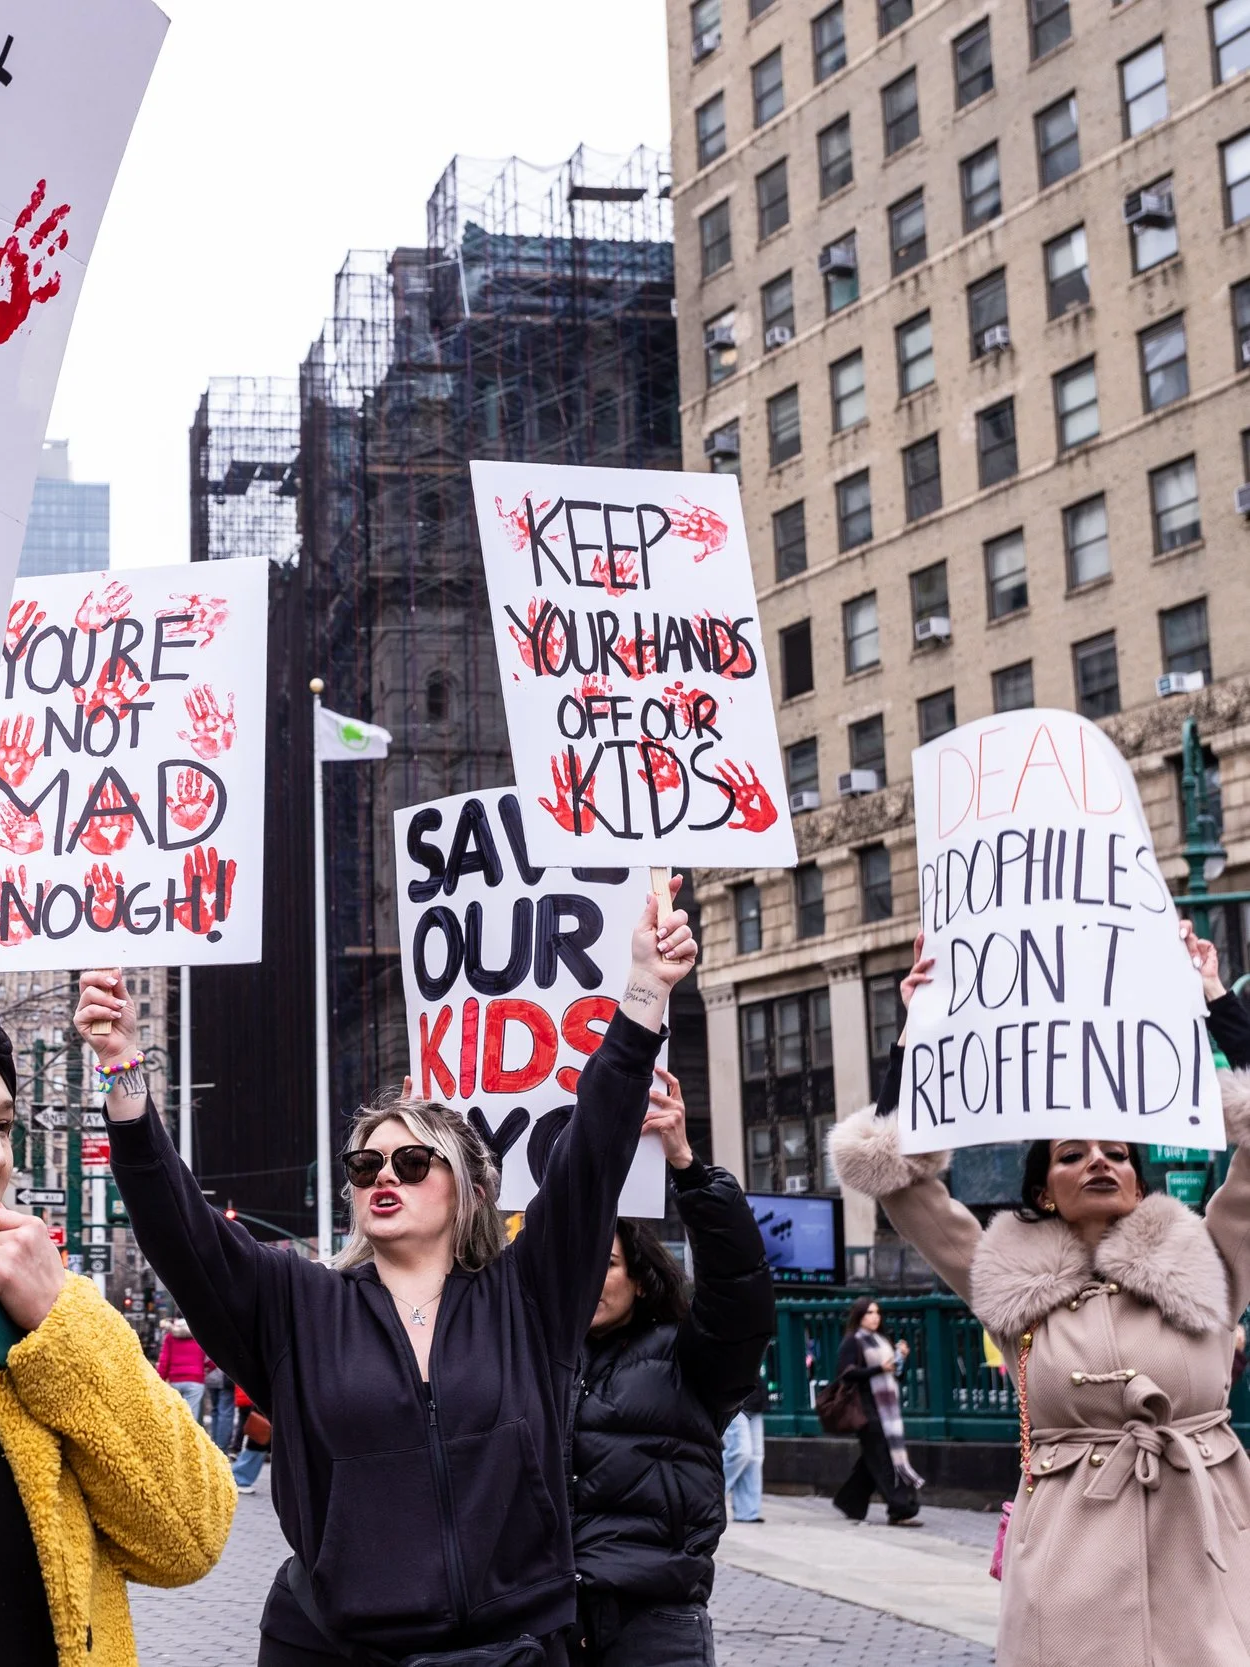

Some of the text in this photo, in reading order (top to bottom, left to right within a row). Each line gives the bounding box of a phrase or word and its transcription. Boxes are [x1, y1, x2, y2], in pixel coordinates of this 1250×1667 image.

[526, 496, 671, 590] KEEP
[2, 614, 197, 699] YOU'RE
[504, 600, 757, 679] YOUR HANDS
[43, 702, 155, 757] NOT
[557, 694, 723, 741] OFF OUR
[568, 740, 736, 840] KIDS
[938, 724, 1123, 839] DEAD
[407, 794, 629, 904] SAV
[921, 828, 1167, 933] PEDOPHILES
[413, 894, 604, 1001] OUR
[948, 922, 1135, 1016] DON'T
[420, 996, 621, 1101] KIDS
[911, 1018, 1201, 1132] REOFFEND!
